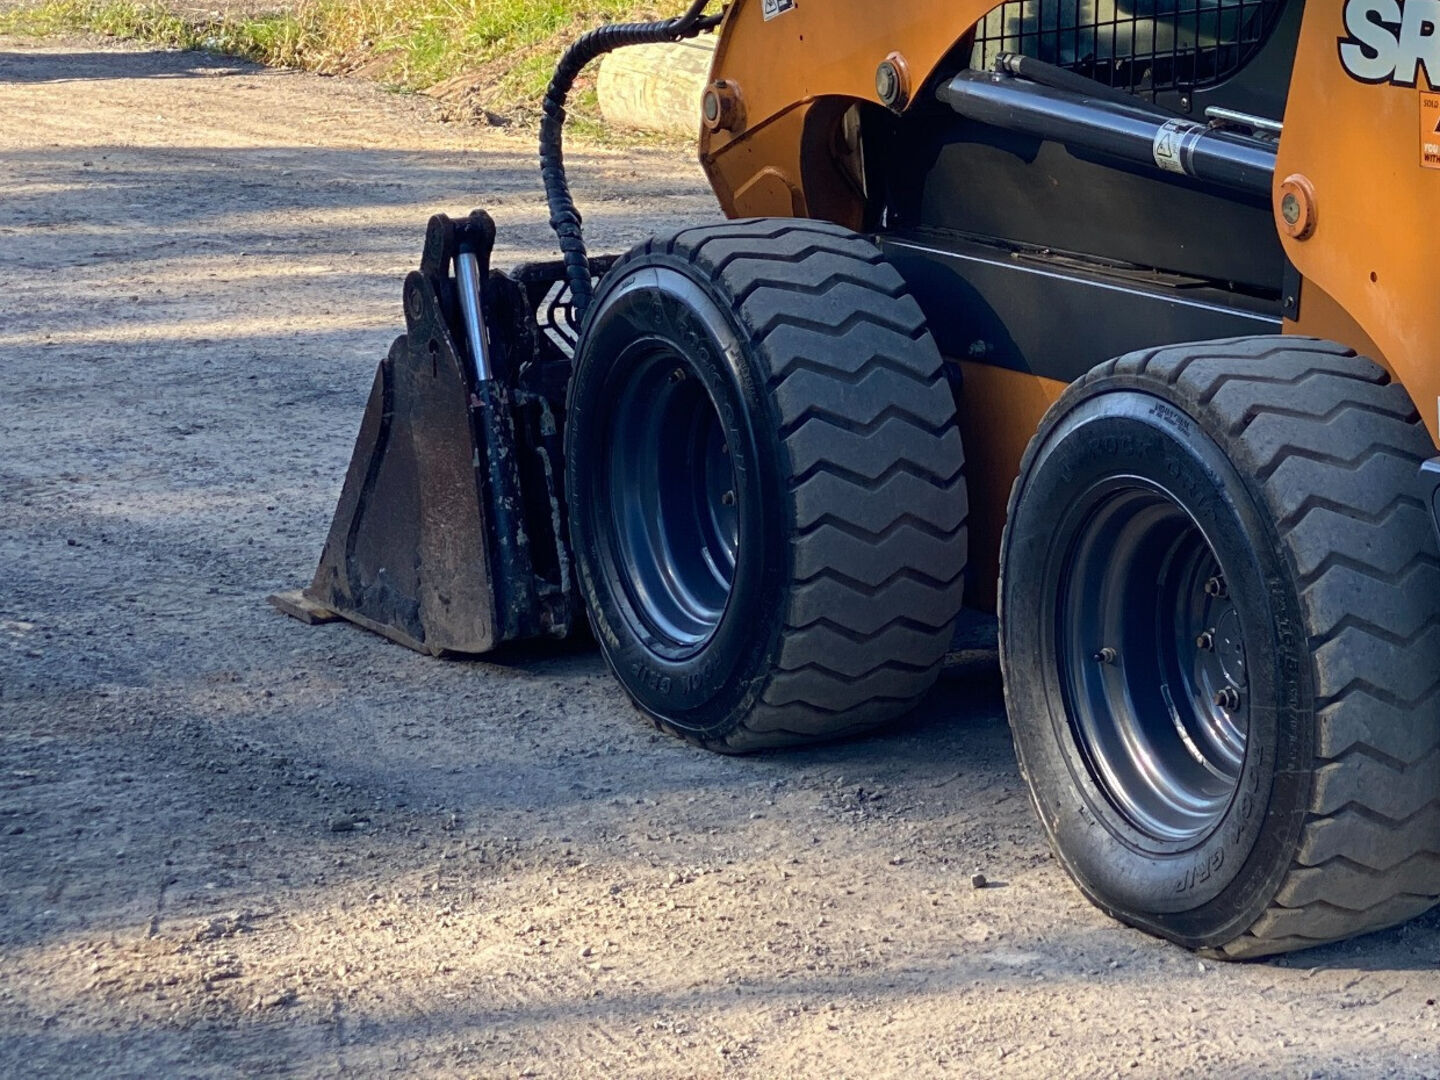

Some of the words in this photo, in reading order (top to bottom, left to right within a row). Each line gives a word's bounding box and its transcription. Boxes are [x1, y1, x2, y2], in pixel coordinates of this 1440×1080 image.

[1423, 99, 1439, 108] SOLD
[1424, 143, 1438, 154] YOU
[1424, 154, 1440, 163] WITH
